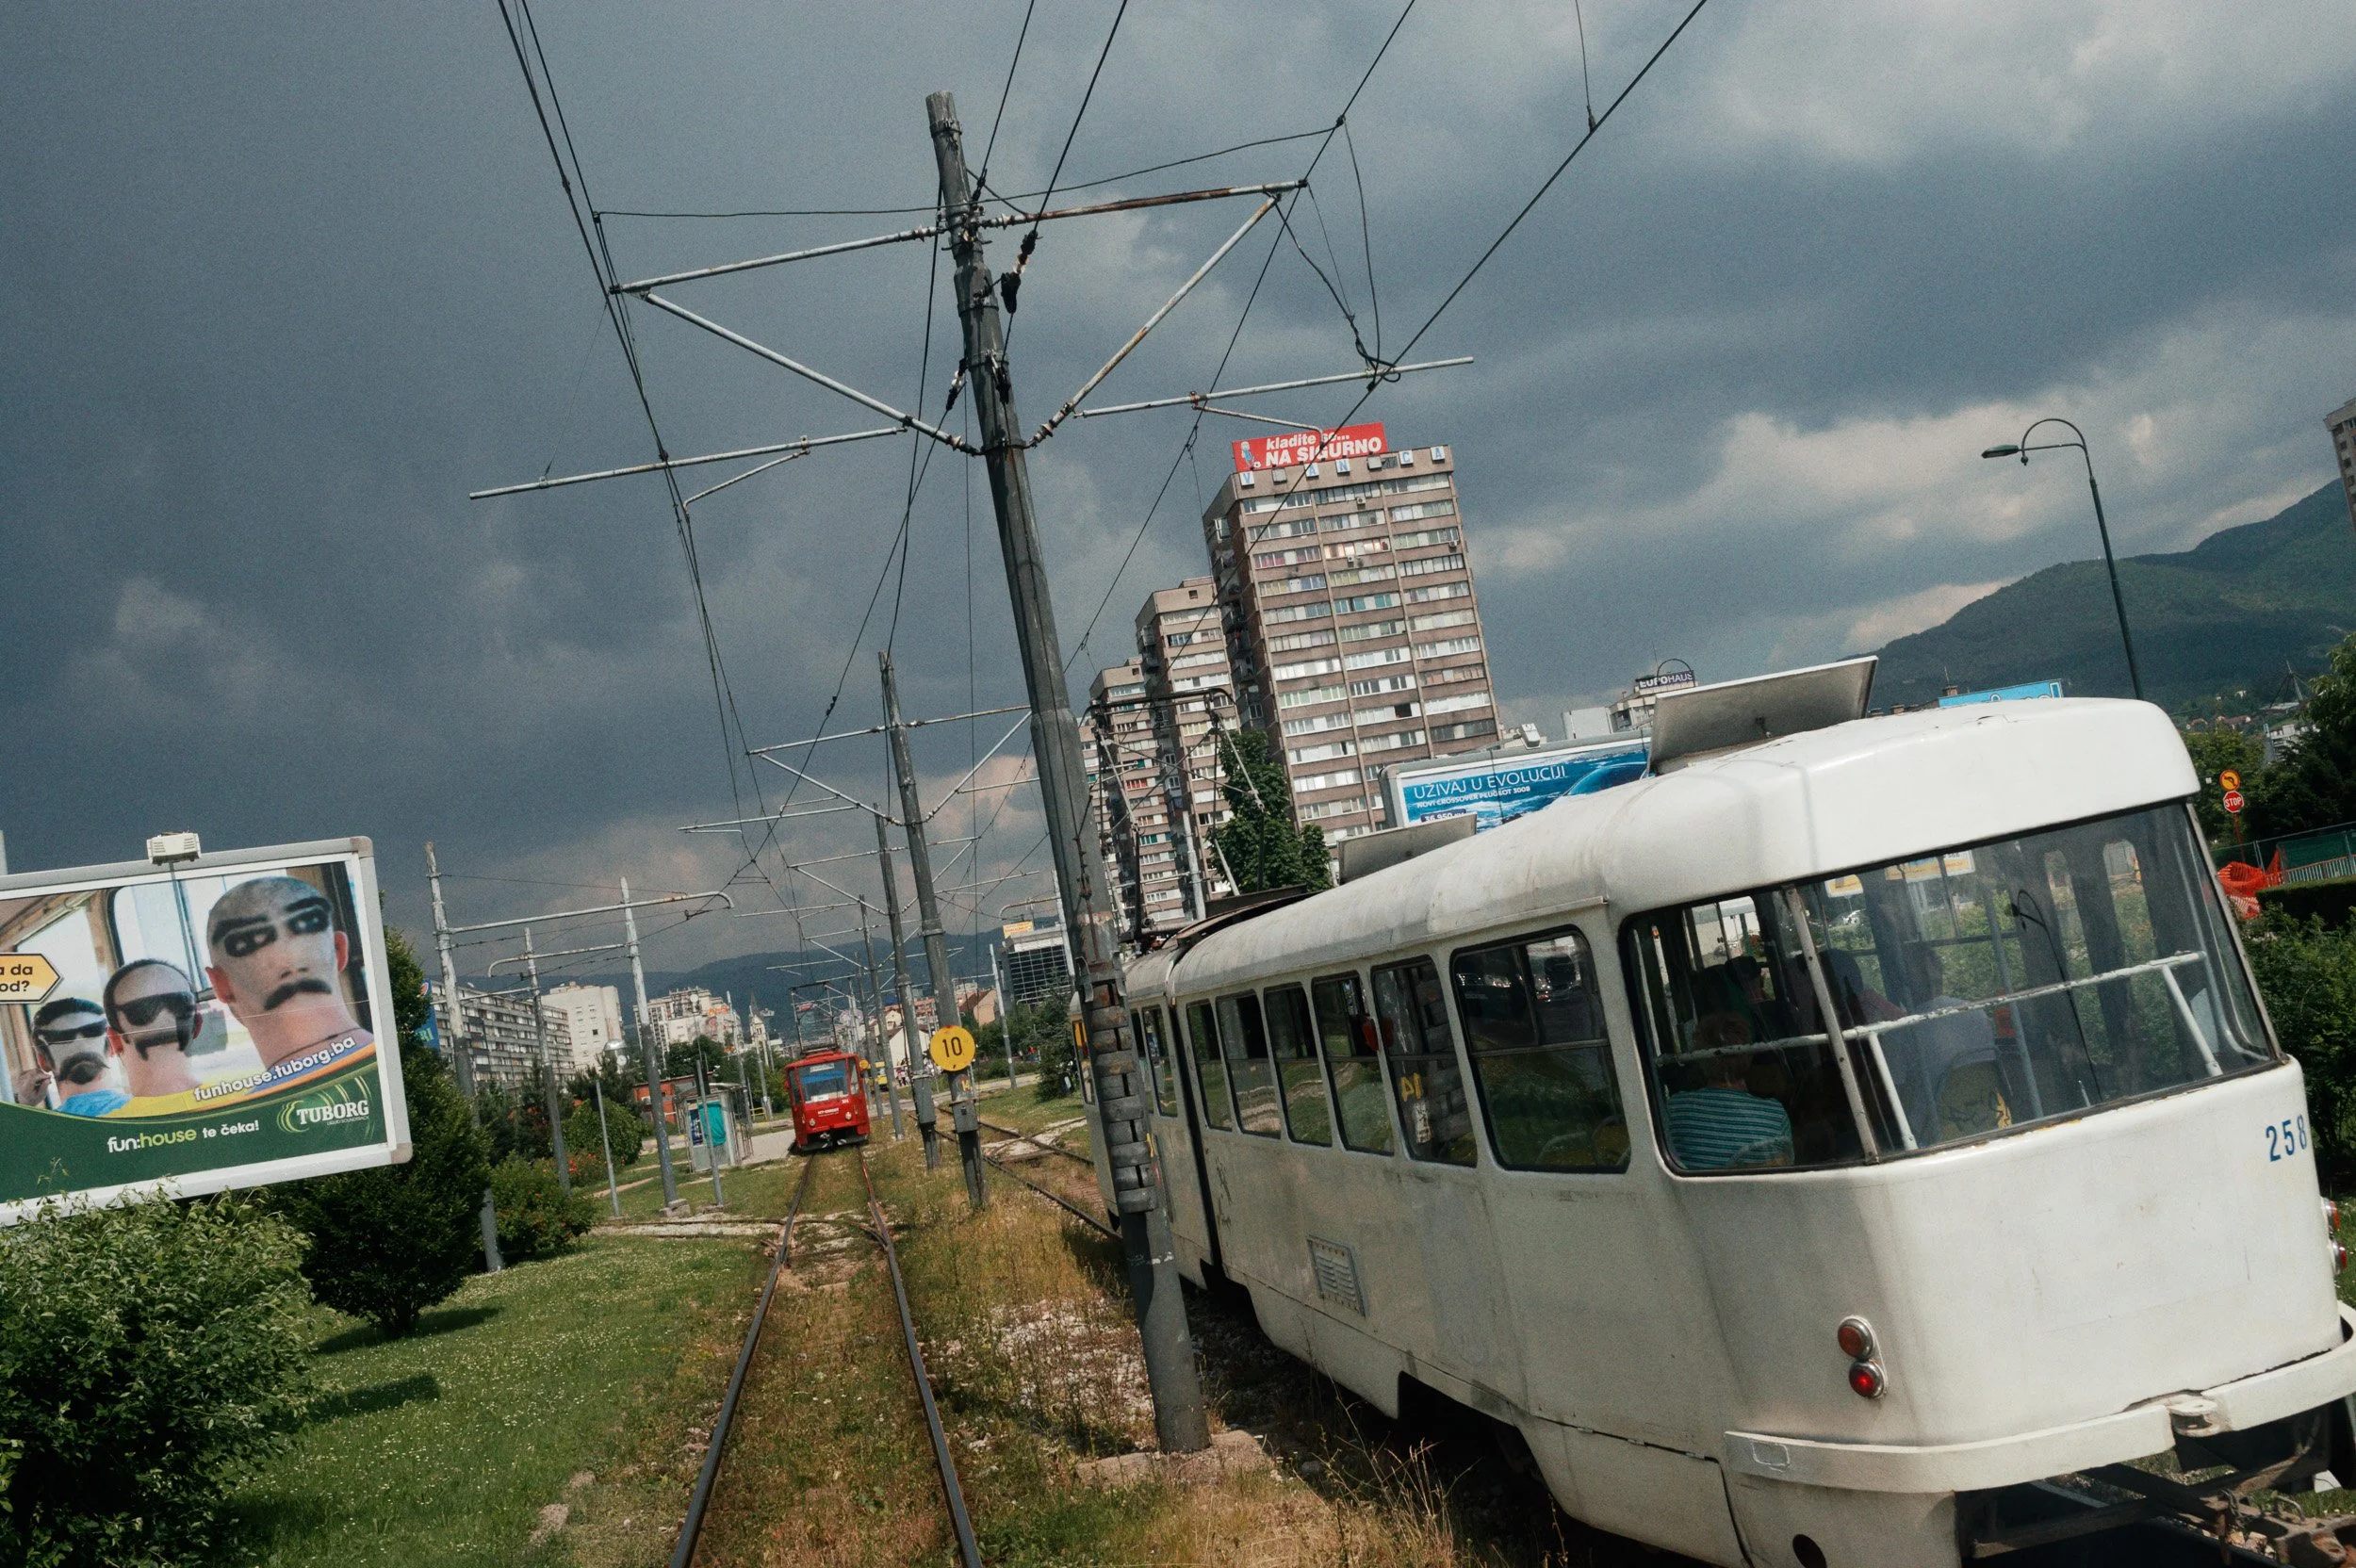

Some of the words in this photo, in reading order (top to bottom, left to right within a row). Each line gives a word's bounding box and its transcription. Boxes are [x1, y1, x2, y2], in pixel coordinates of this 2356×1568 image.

[1266, 433, 1317, 450] kladite
[1266, 449, 1292, 467] NA
[1297, 436, 1383, 462] SIGURNO
[1414, 780, 1466, 799] UŽIVAJ
[1471, 777, 1482, 791] U
[1487, 765, 1566, 788] EVOLUCIJI
[2225, 796, 2242, 808] STOP
[10, 963, 33, 975] da
[942, 1037, 962, 1057] 10
[193, 1035, 356, 1102] funhouse.tuborg.ba
[296, 1100, 369, 1125] TUBORG
[203, 1127, 217, 1138] te
[221, 1119, 259, 1135] čeka!
[2266, 1114, 2307, 1162] 258
